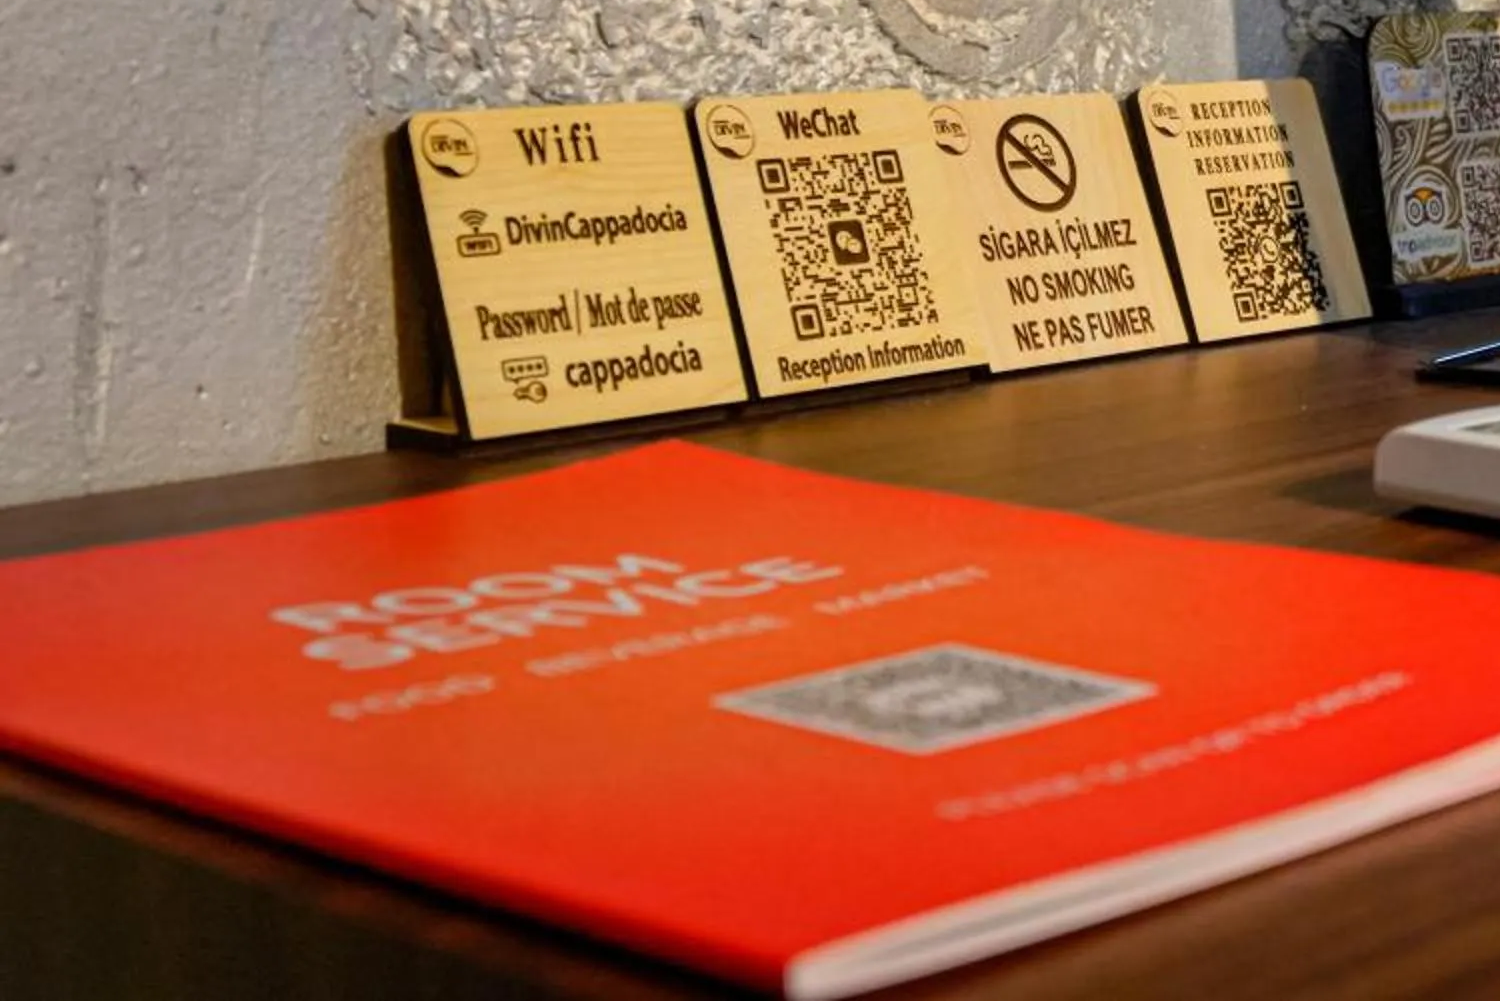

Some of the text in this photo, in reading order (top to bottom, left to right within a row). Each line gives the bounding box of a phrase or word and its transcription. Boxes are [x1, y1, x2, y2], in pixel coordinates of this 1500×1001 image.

[777, 106, 861, 140] WeChat
[1190, 99, 1271, 121] RECEPTION
[514, 122, 600, 166] Wifi
[1186, 123, 1288, 148] INFORMATION
[1194, 150, 1295, 176] RESERVATION
[505, 203, 687, 246] DivinCappadocia
[978, 216, 1137, 262] SİGARA İÇİLMEZ
[1006, 262, 1135, 307] NO SMOKING
[475, 294, 573, 340] Password
[584, 292, 626, 328] Mot
[627, 286, 651, 324] de
[651, 291, 703, 330] passe
[1012, 305, 1155, 353] NE PAS FUMER
[565, 341, 703, 392] cappadocia
[777, 334, 965, 383] Reception Information
[269, 552, 685, 632] ROOM
[303, 555, 845, 670] SERVICE
